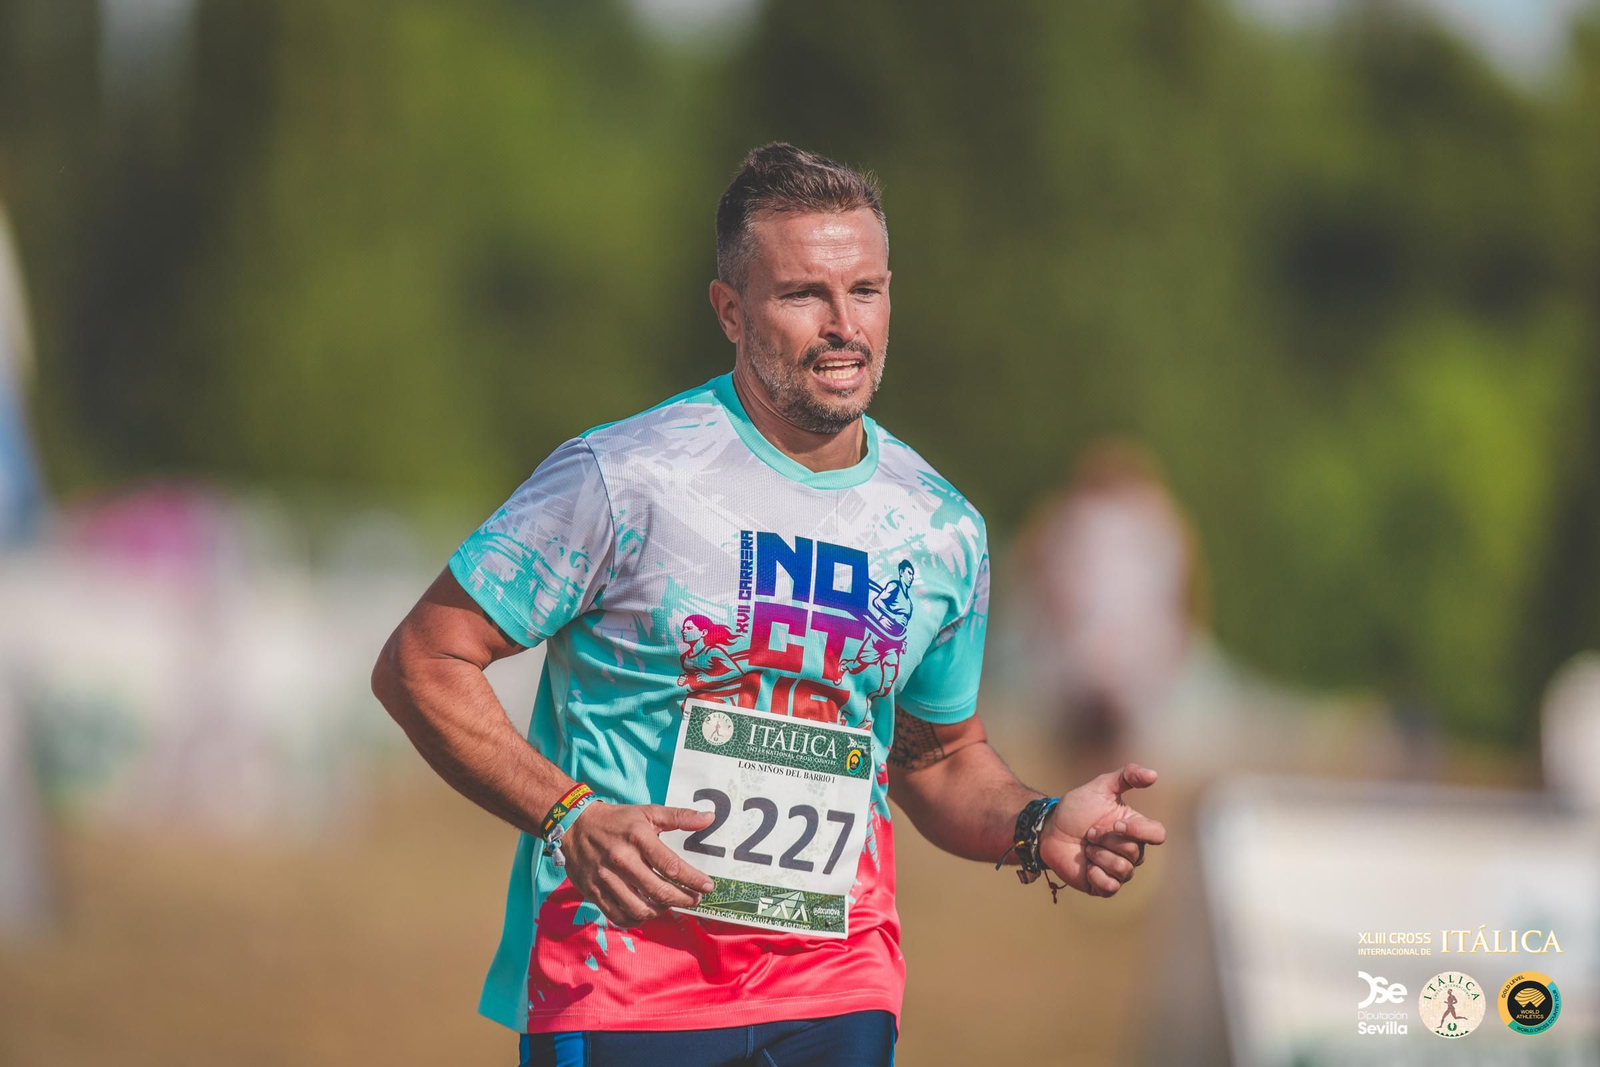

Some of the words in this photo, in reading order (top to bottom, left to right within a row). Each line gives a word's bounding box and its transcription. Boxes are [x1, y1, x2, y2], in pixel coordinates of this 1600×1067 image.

[739, 530, 753, 600] CARRERA
[755, 531, 869, 611] NO
[736, 605, 751, 633] XVII
[748, 601, 867, 682] CT
[748, 723, 838, 759] ITÁLICA
[738, 760, 756, 771] LOS
[757, 763, 785, 775] NIÑOS
[785, 768, 802, 778] DEL
[803, 771, 830, 783] BARRIO
[683, 788, 856, 876] 2227
[696, 907, 738, 921] FEDERACIÓN
[740, 915, 773, 926] ANDALUZA
